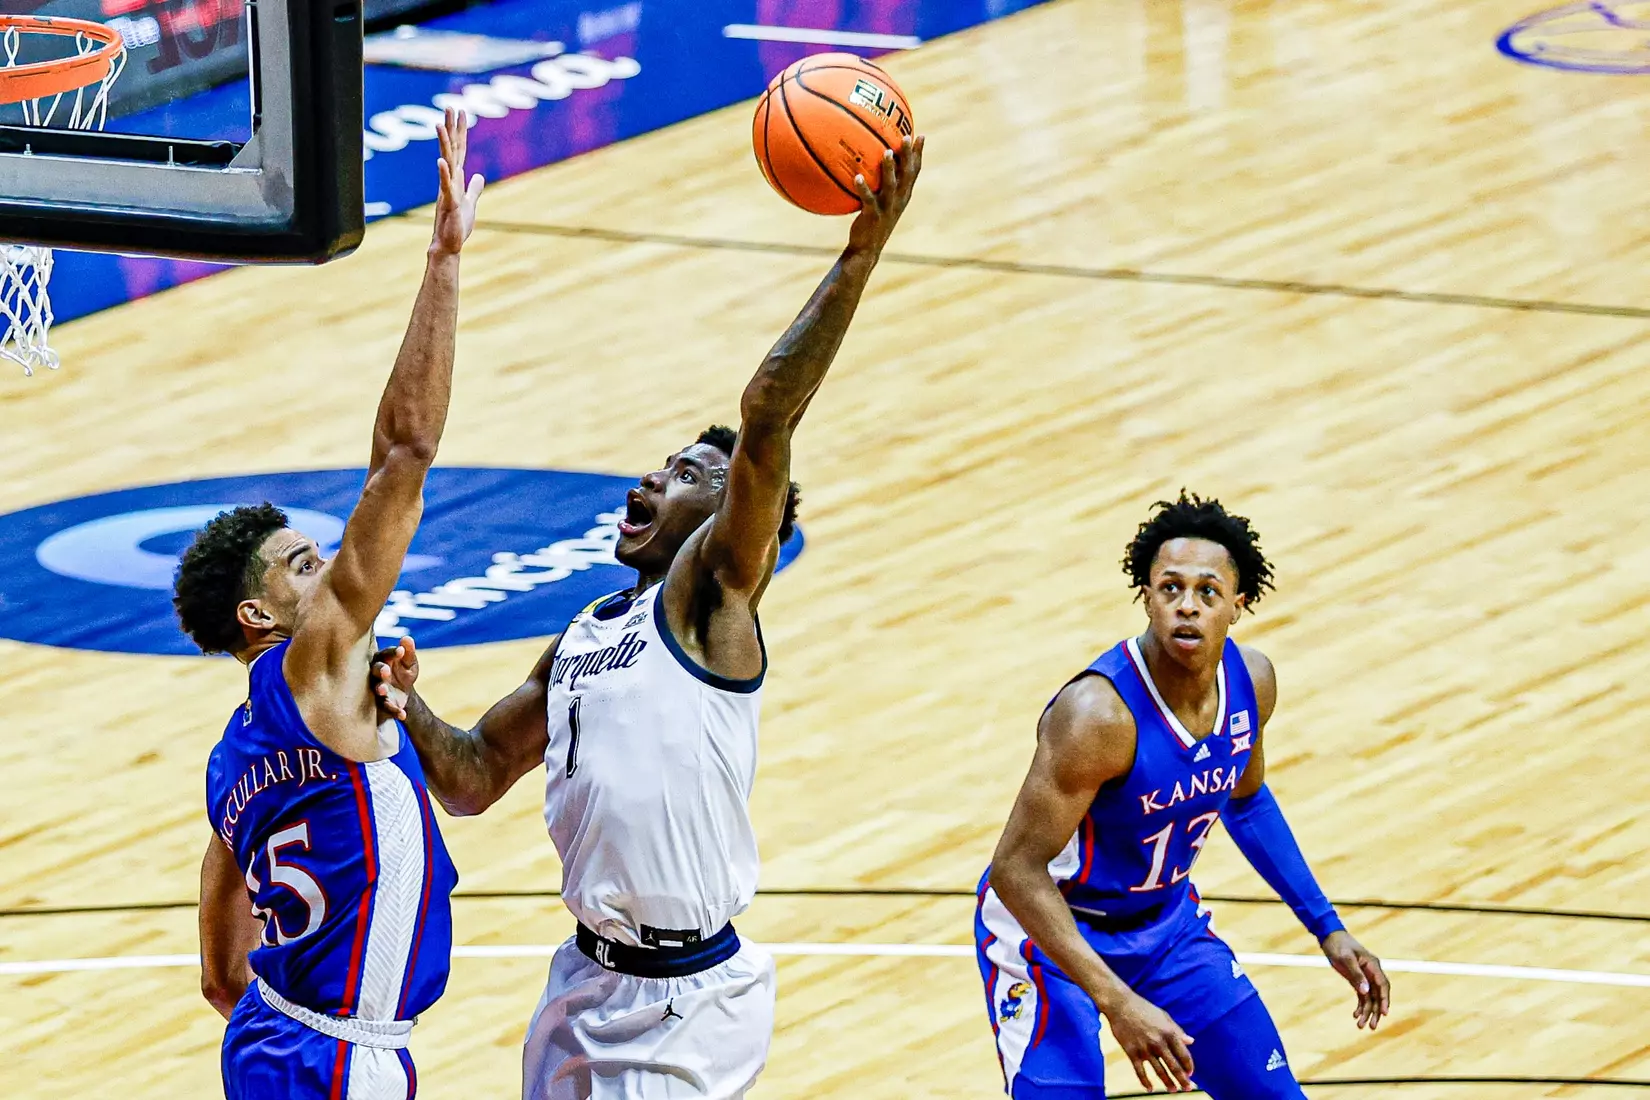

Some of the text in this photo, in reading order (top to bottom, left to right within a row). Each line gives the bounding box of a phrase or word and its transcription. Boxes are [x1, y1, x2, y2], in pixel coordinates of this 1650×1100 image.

[853, 79, 912, 136] ELITE
[566, 697, 581, 778] 1
[297, 748, 337, 787] JR.
[1139, 765, 1244, 815] KANSA
[1130, 810, 1220, 892] 13
